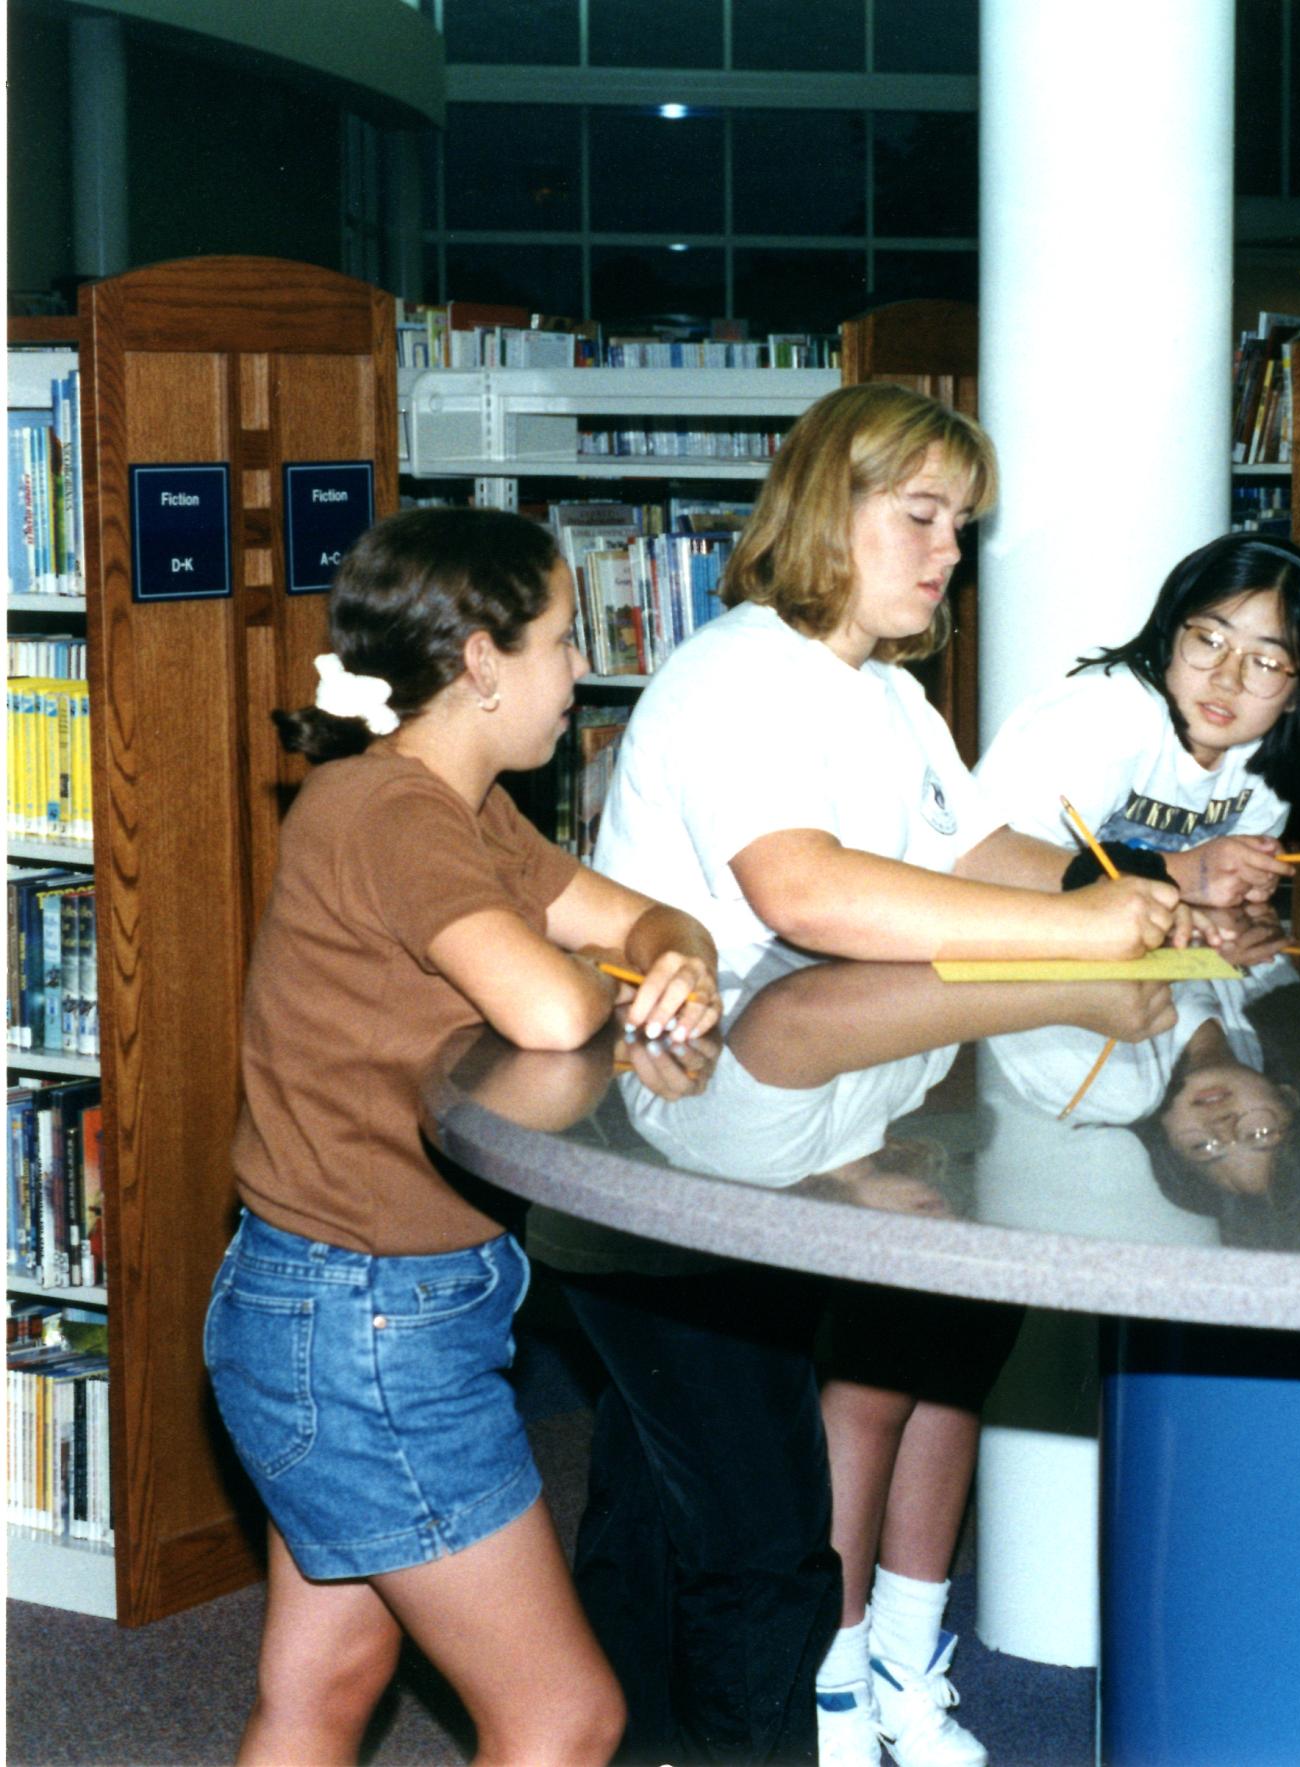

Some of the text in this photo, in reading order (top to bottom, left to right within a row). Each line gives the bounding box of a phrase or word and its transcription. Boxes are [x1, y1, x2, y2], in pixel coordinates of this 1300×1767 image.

[161, 492, 200, 506] Fiction
[312, 488, 348, 503] Fiction
[172, 558, 194, 573] D-K
[320, 552, 341, 566] A-C
